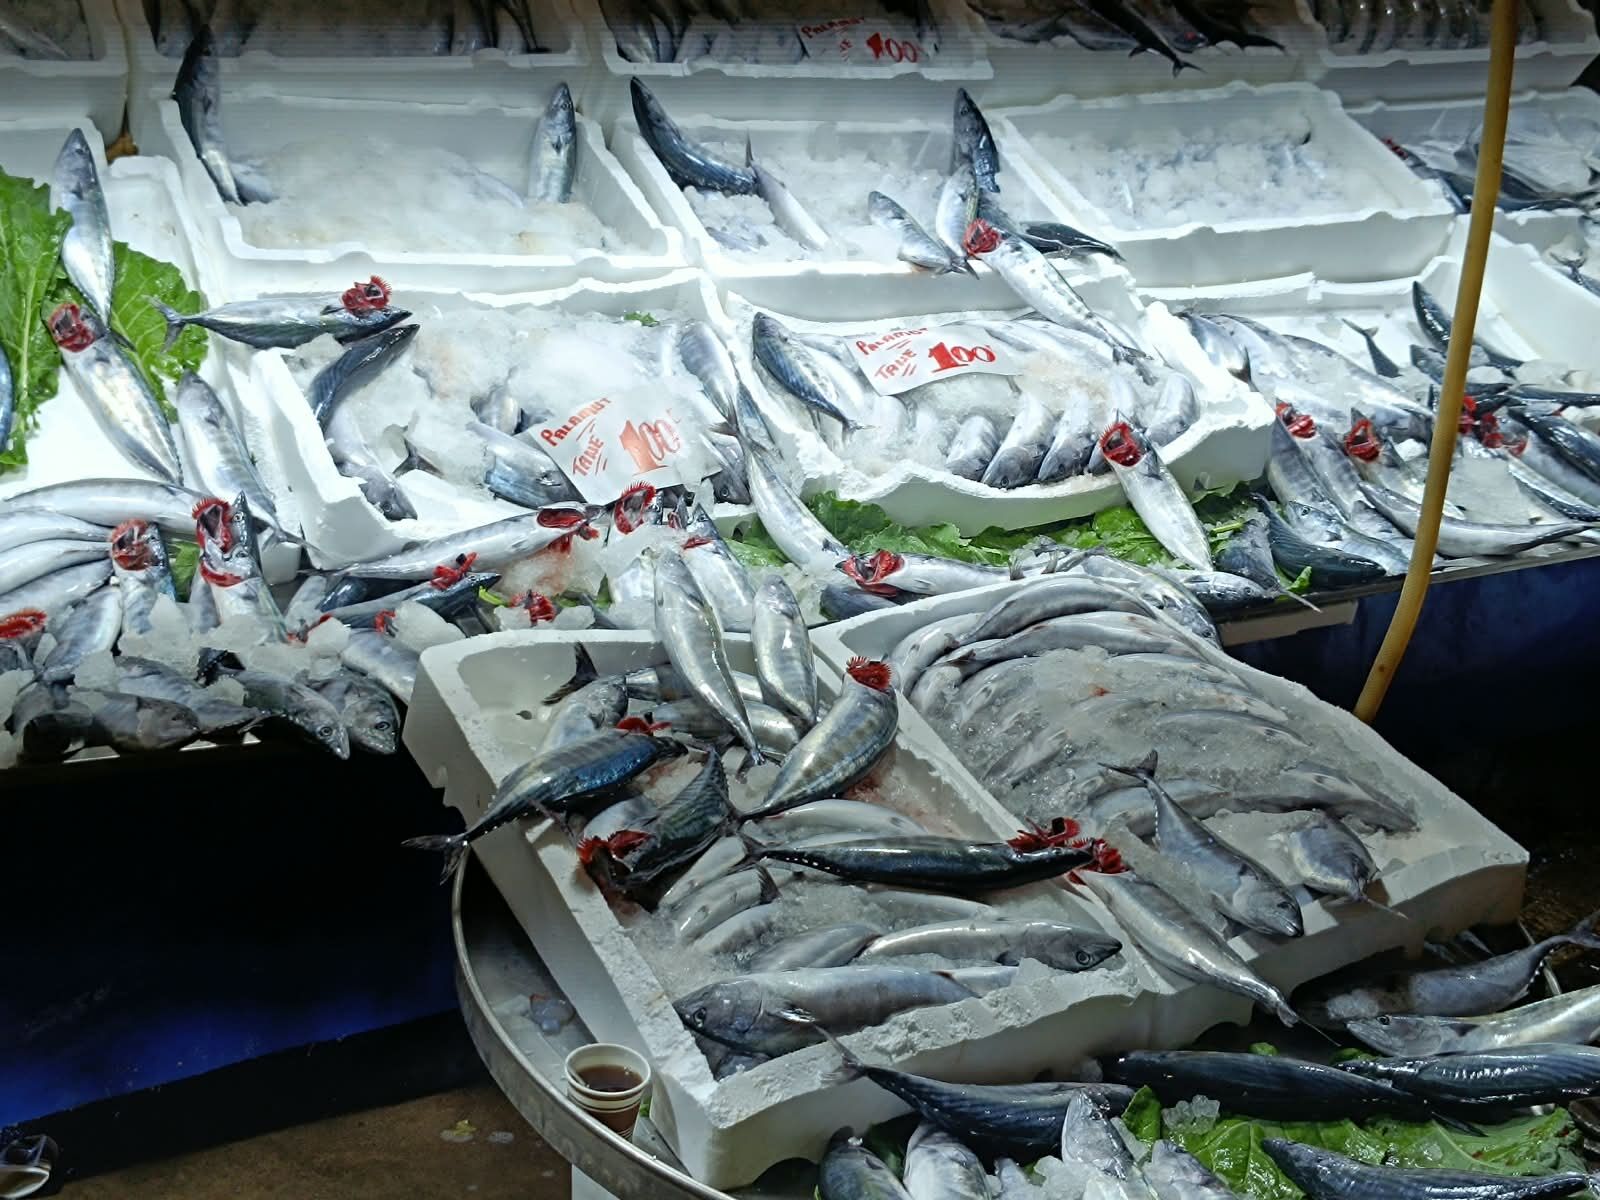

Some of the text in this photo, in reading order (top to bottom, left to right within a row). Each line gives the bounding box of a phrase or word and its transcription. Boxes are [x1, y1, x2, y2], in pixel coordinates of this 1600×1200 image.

[866, 32, 917, 63] 100
[928, 341, 996, 373] 100
[618, 419, 681, 476] 100
